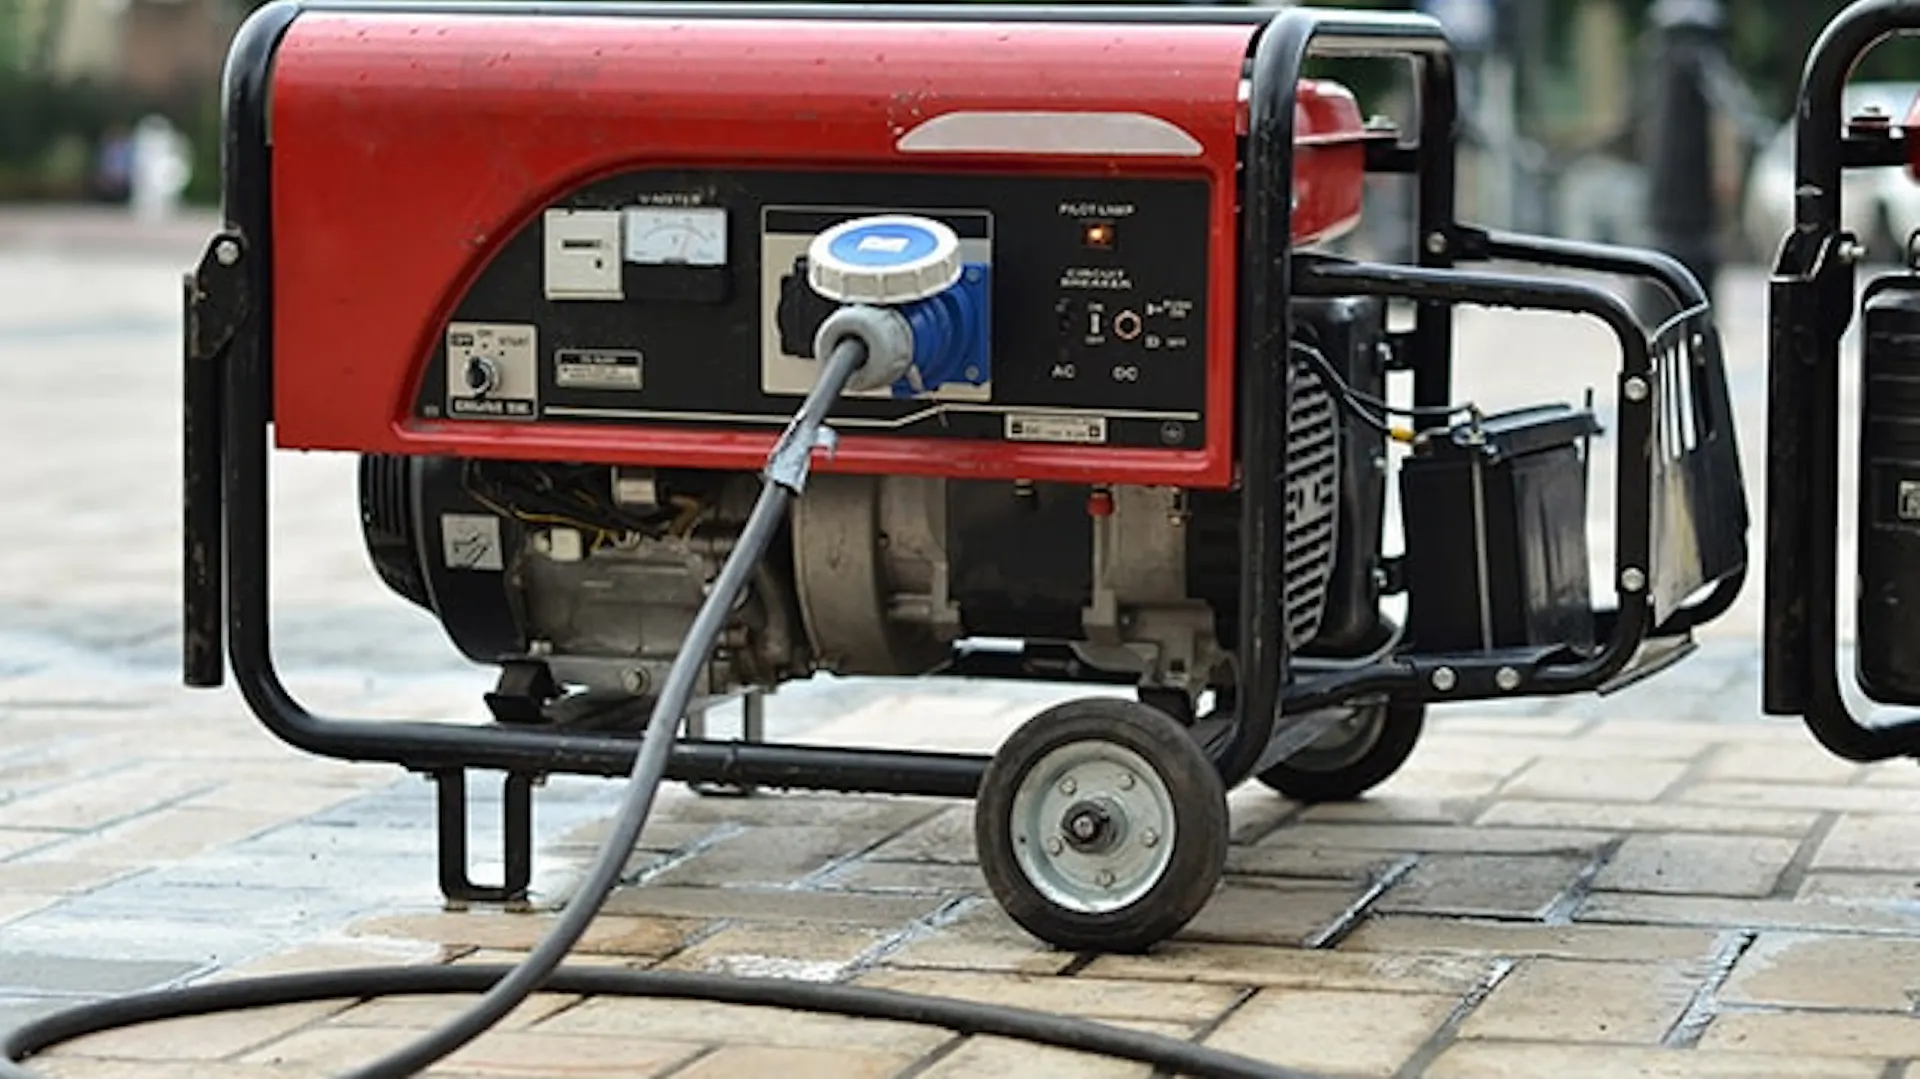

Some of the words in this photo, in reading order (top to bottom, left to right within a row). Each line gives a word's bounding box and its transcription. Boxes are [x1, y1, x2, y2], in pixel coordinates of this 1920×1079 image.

[1059, 203, 1096, 216] PILOT
[1098, 204, 1135, 217] LAMP
[1066, 268, 1124, 279] CIRCUIT
[1060, 278, 1133, 290] BREAKER
[1051, 363, 1076, 380] AC
[1112, 365, 1139, 382] DC
[454, 400, 504, 414] ENGINE
